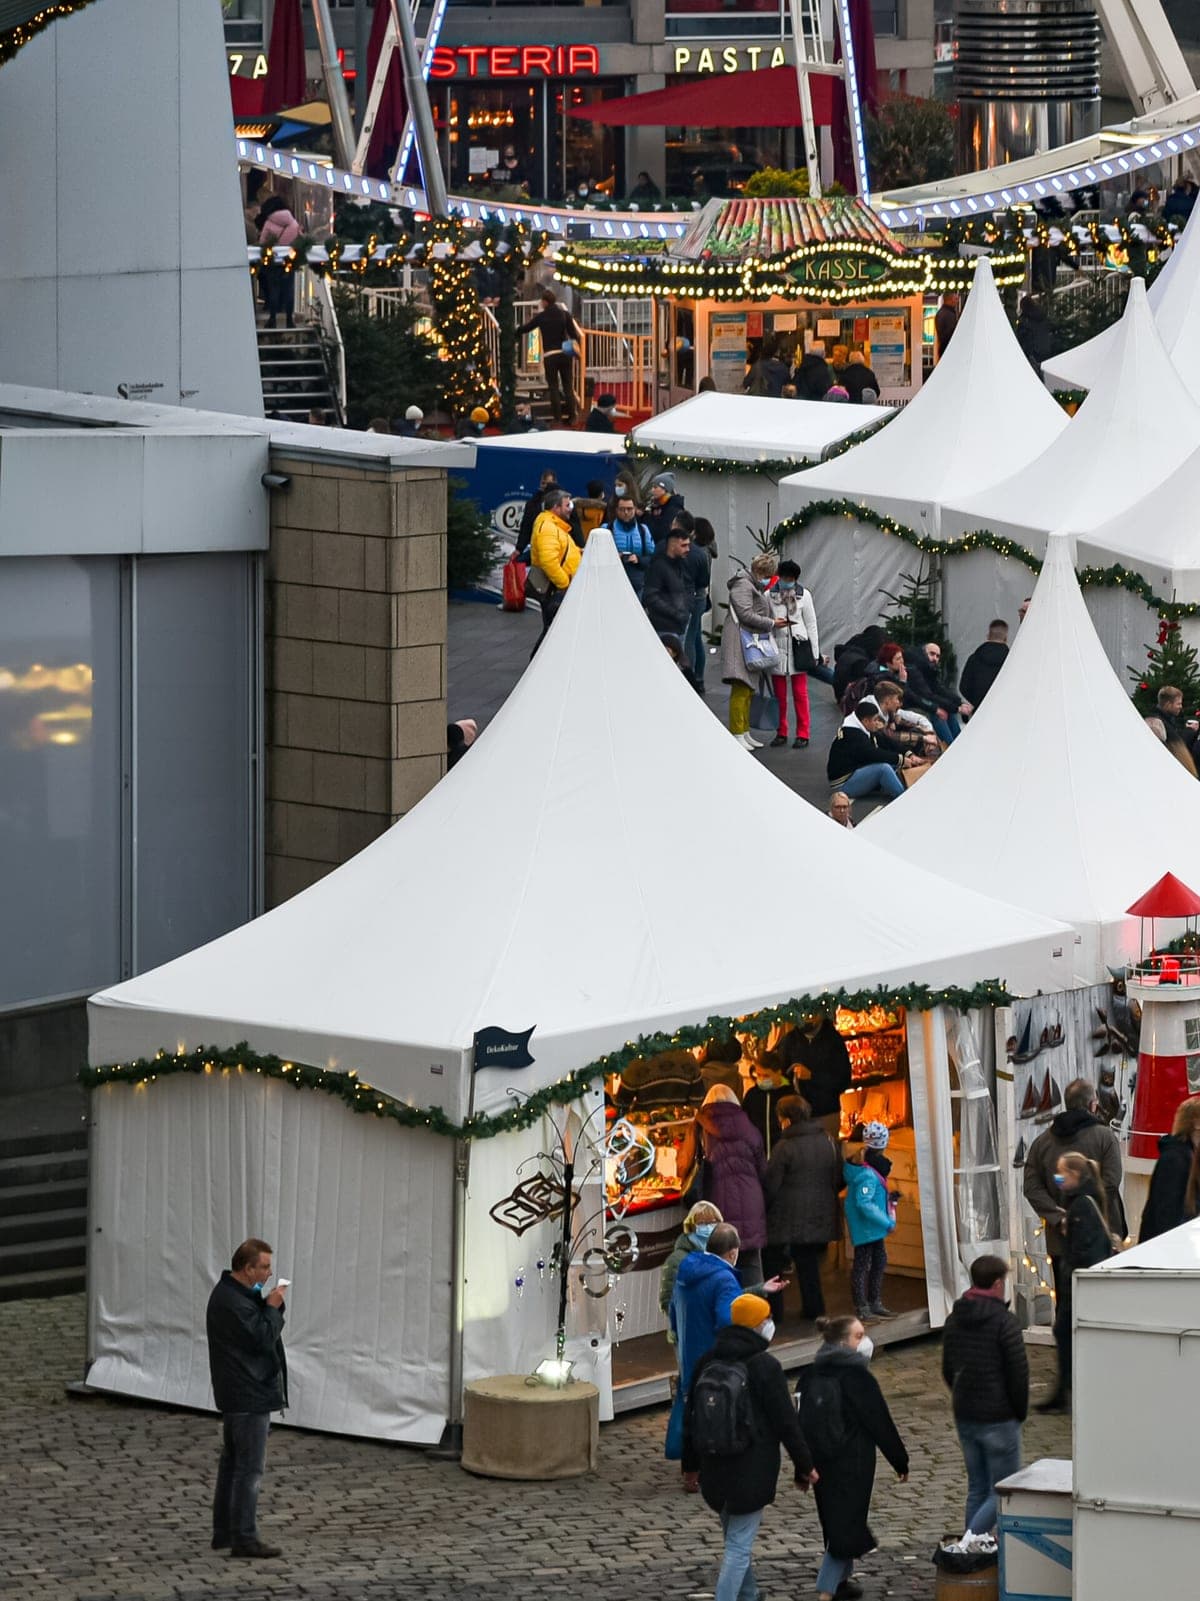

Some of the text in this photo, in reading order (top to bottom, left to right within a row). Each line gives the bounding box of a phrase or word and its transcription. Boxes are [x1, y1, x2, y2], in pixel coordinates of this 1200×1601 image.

[675, 46, 786, 73] PASTA
[805, 258, 870, 280] KASSE
[878, 399, 912, 407] USEUM
